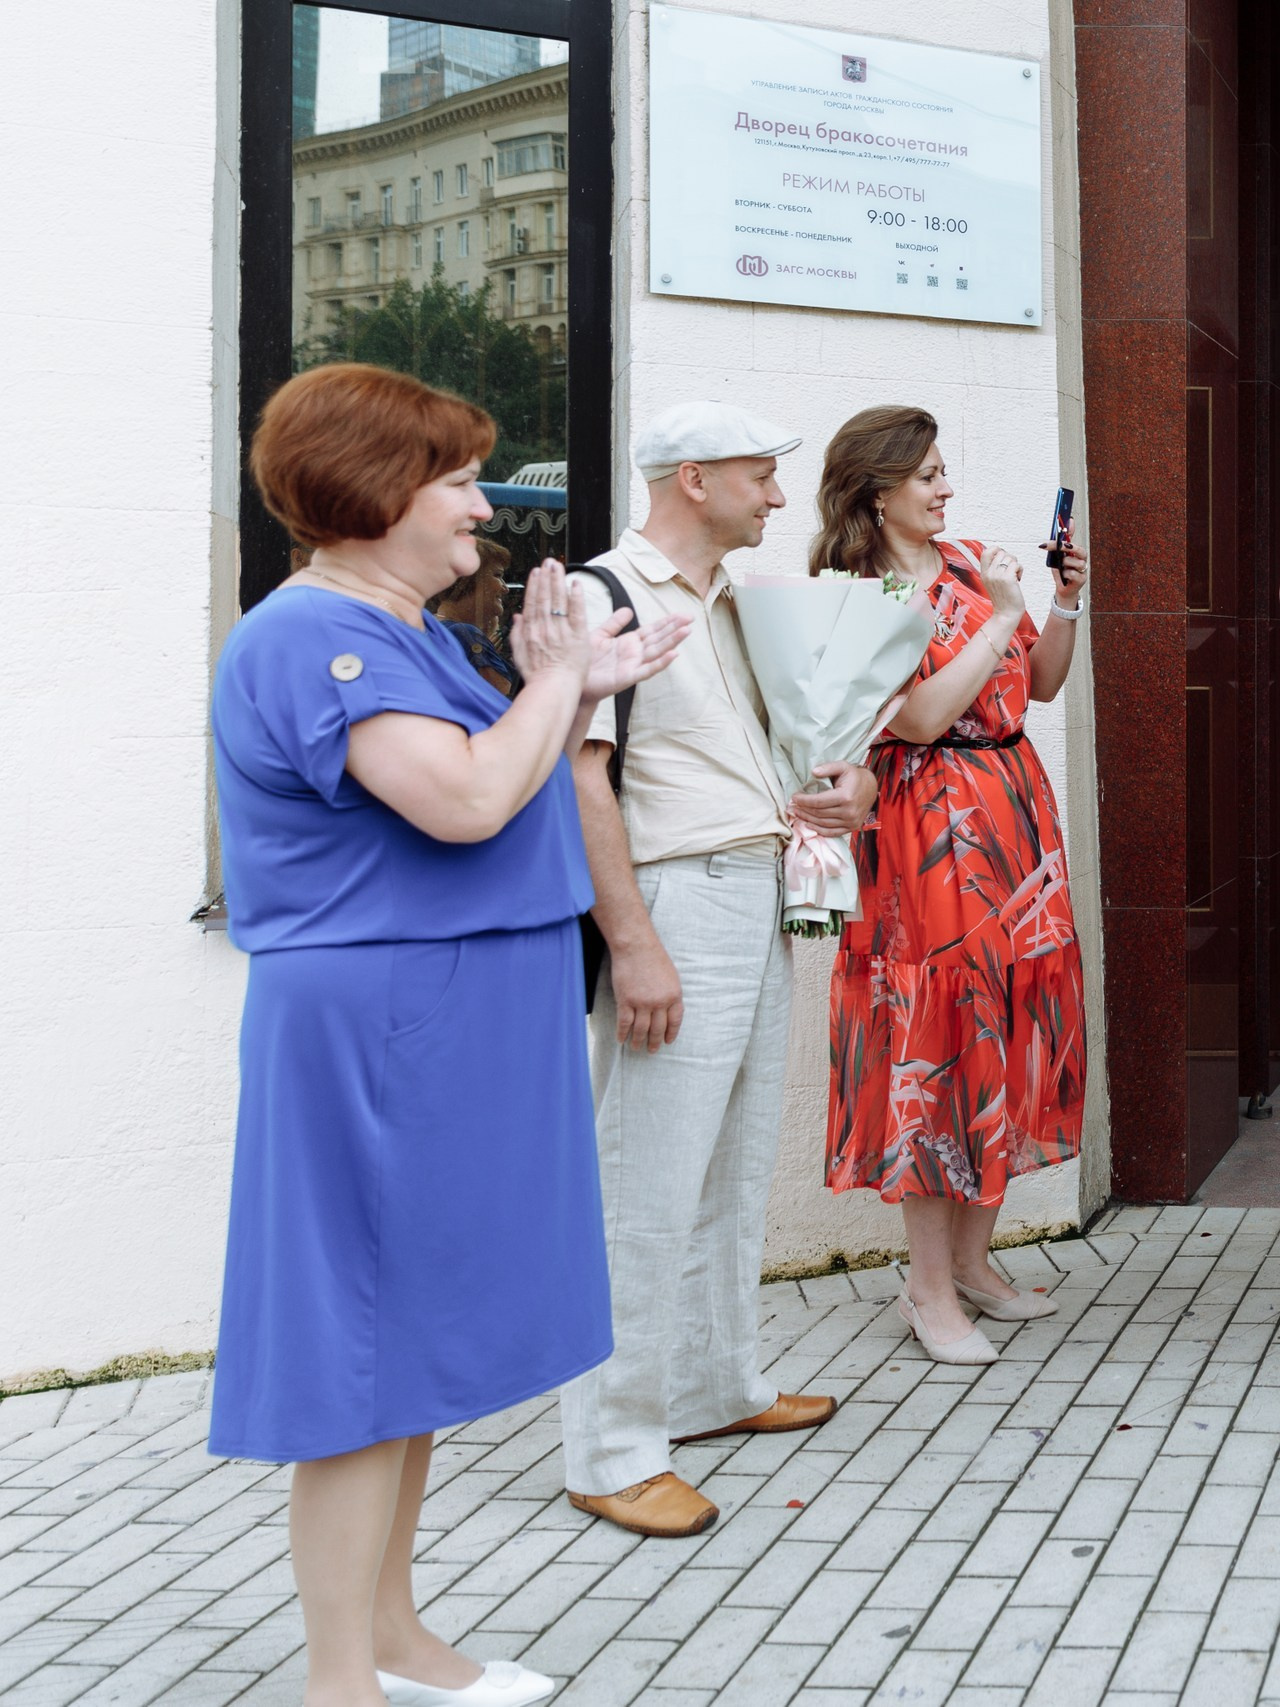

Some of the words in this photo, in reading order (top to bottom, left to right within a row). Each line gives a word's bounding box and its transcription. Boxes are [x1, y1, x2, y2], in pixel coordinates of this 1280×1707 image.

[751, 79, 797, 92] УПРАВЛЕНИЕ
[798, 86, 829, 96] ЗАПИСИ
[830, 91, 853, 100] АКТОВ
[855, 94, 911, 107] ГРАЖДАНСКОГО
[911, 102, 954, 113] СОСТОЯНИЯ
[823, 100, 852, 111] ГОРОДА
[854, 104, 885, 114] МОСКВЫ
[734, 112, 810, 139] Дворец
[816, 121, 968, 157] бракосочетания
[782, 173, 850, 194] РЕЖИМ
[857, 181, 925, 203] РАБОТЫ
[735, 199, 771, 210] ВТОРНИК
[777, 203, 812, 214] СУББОТА
[867, 209, 905, 227] 9:00
[924, 214, 968, 234] 18:00
[735, 225, 789, 237] ВОСКРЕСЕНЬЕ
[795, 231, 853, 243] ПОНЕДЕЛЬНИК
[895, 242, 939, 253] ВЫХОДНОЙ
[776, 264, 804, 275] ЗАГС
[806, 267, 857, 280] МОСКВЫ
